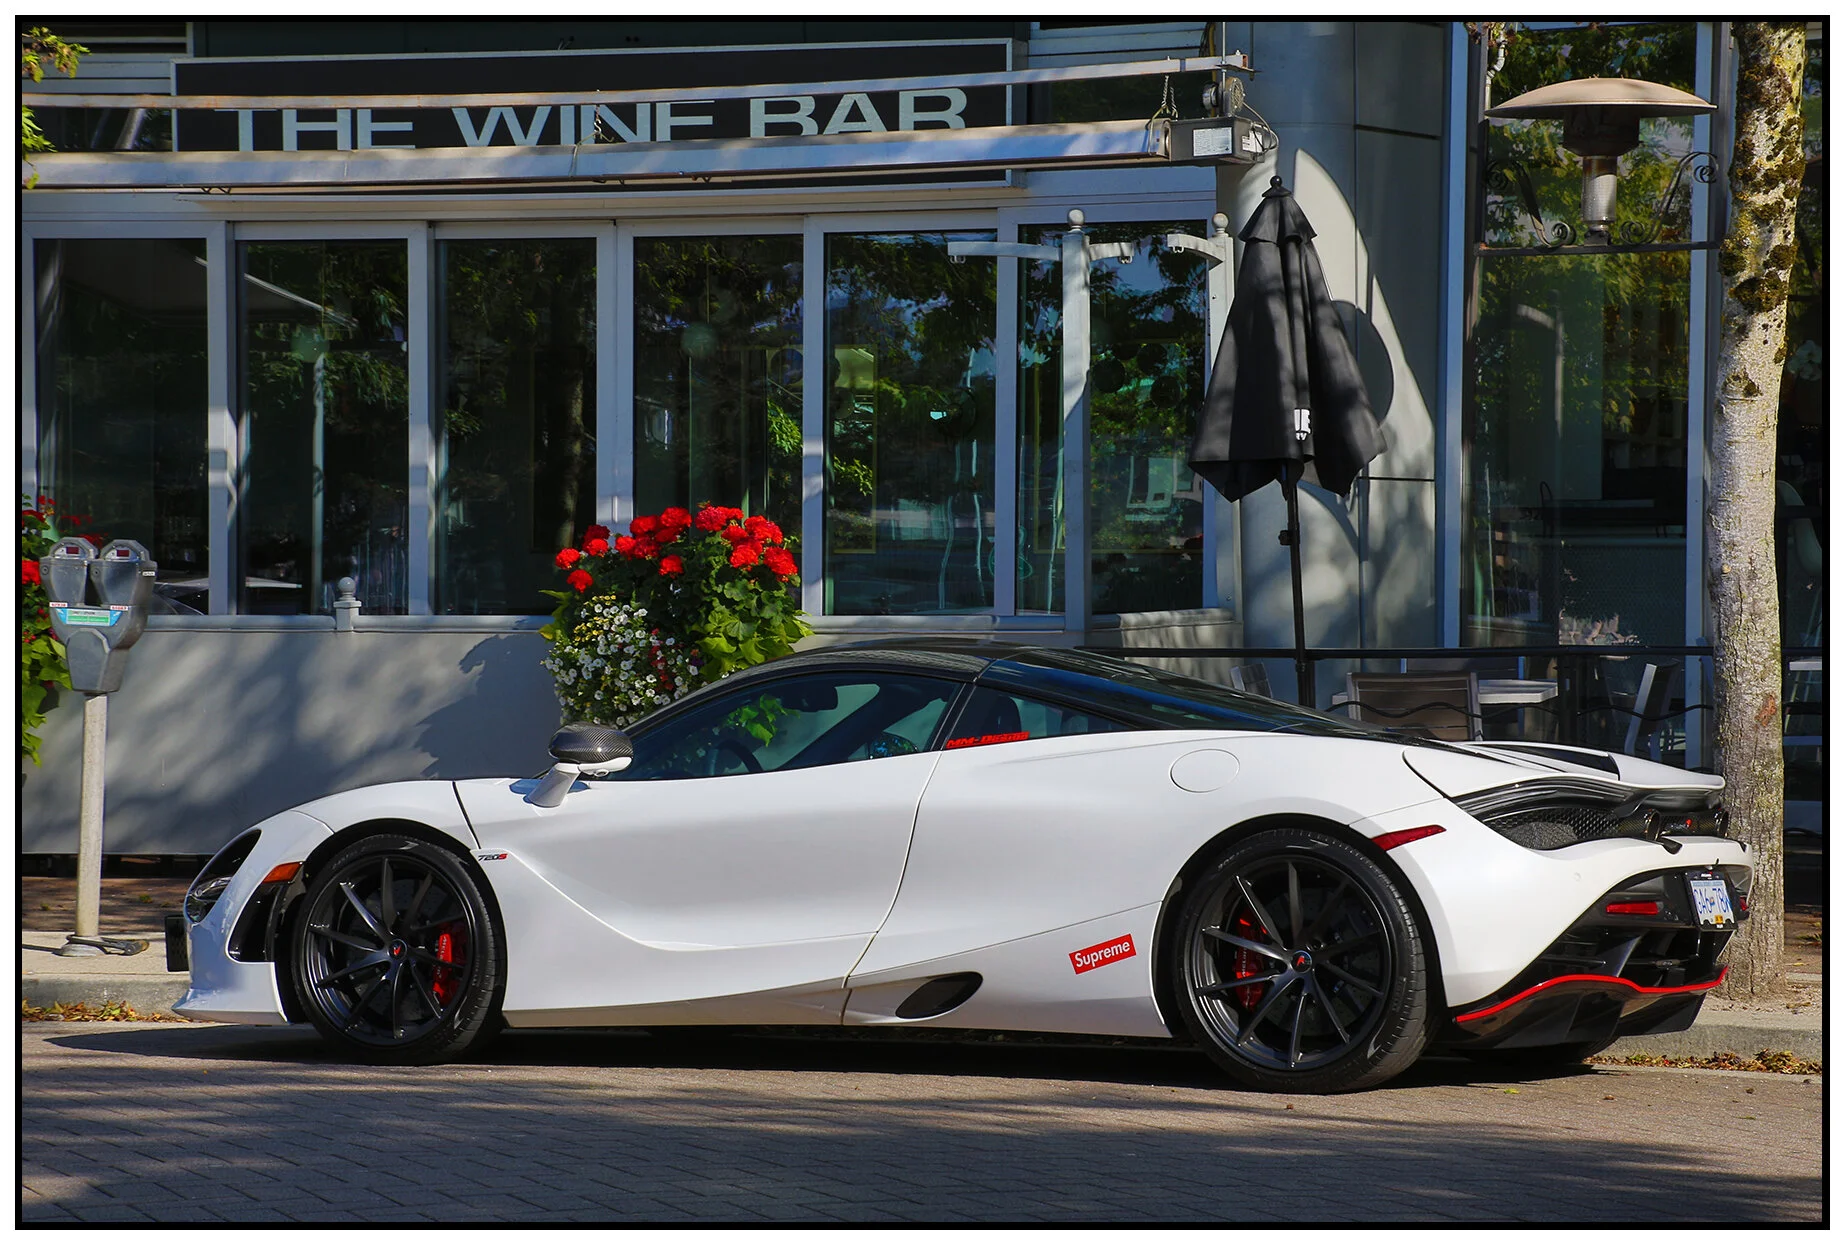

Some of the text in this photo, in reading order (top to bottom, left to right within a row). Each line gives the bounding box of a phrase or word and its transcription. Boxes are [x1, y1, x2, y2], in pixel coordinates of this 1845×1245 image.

[214, 107, 416, 151] THE
[749, 87, 968, 137] BAR
[478, 853, 508, 862] 720S
[1074, 941, 1131, 968] Supreme
